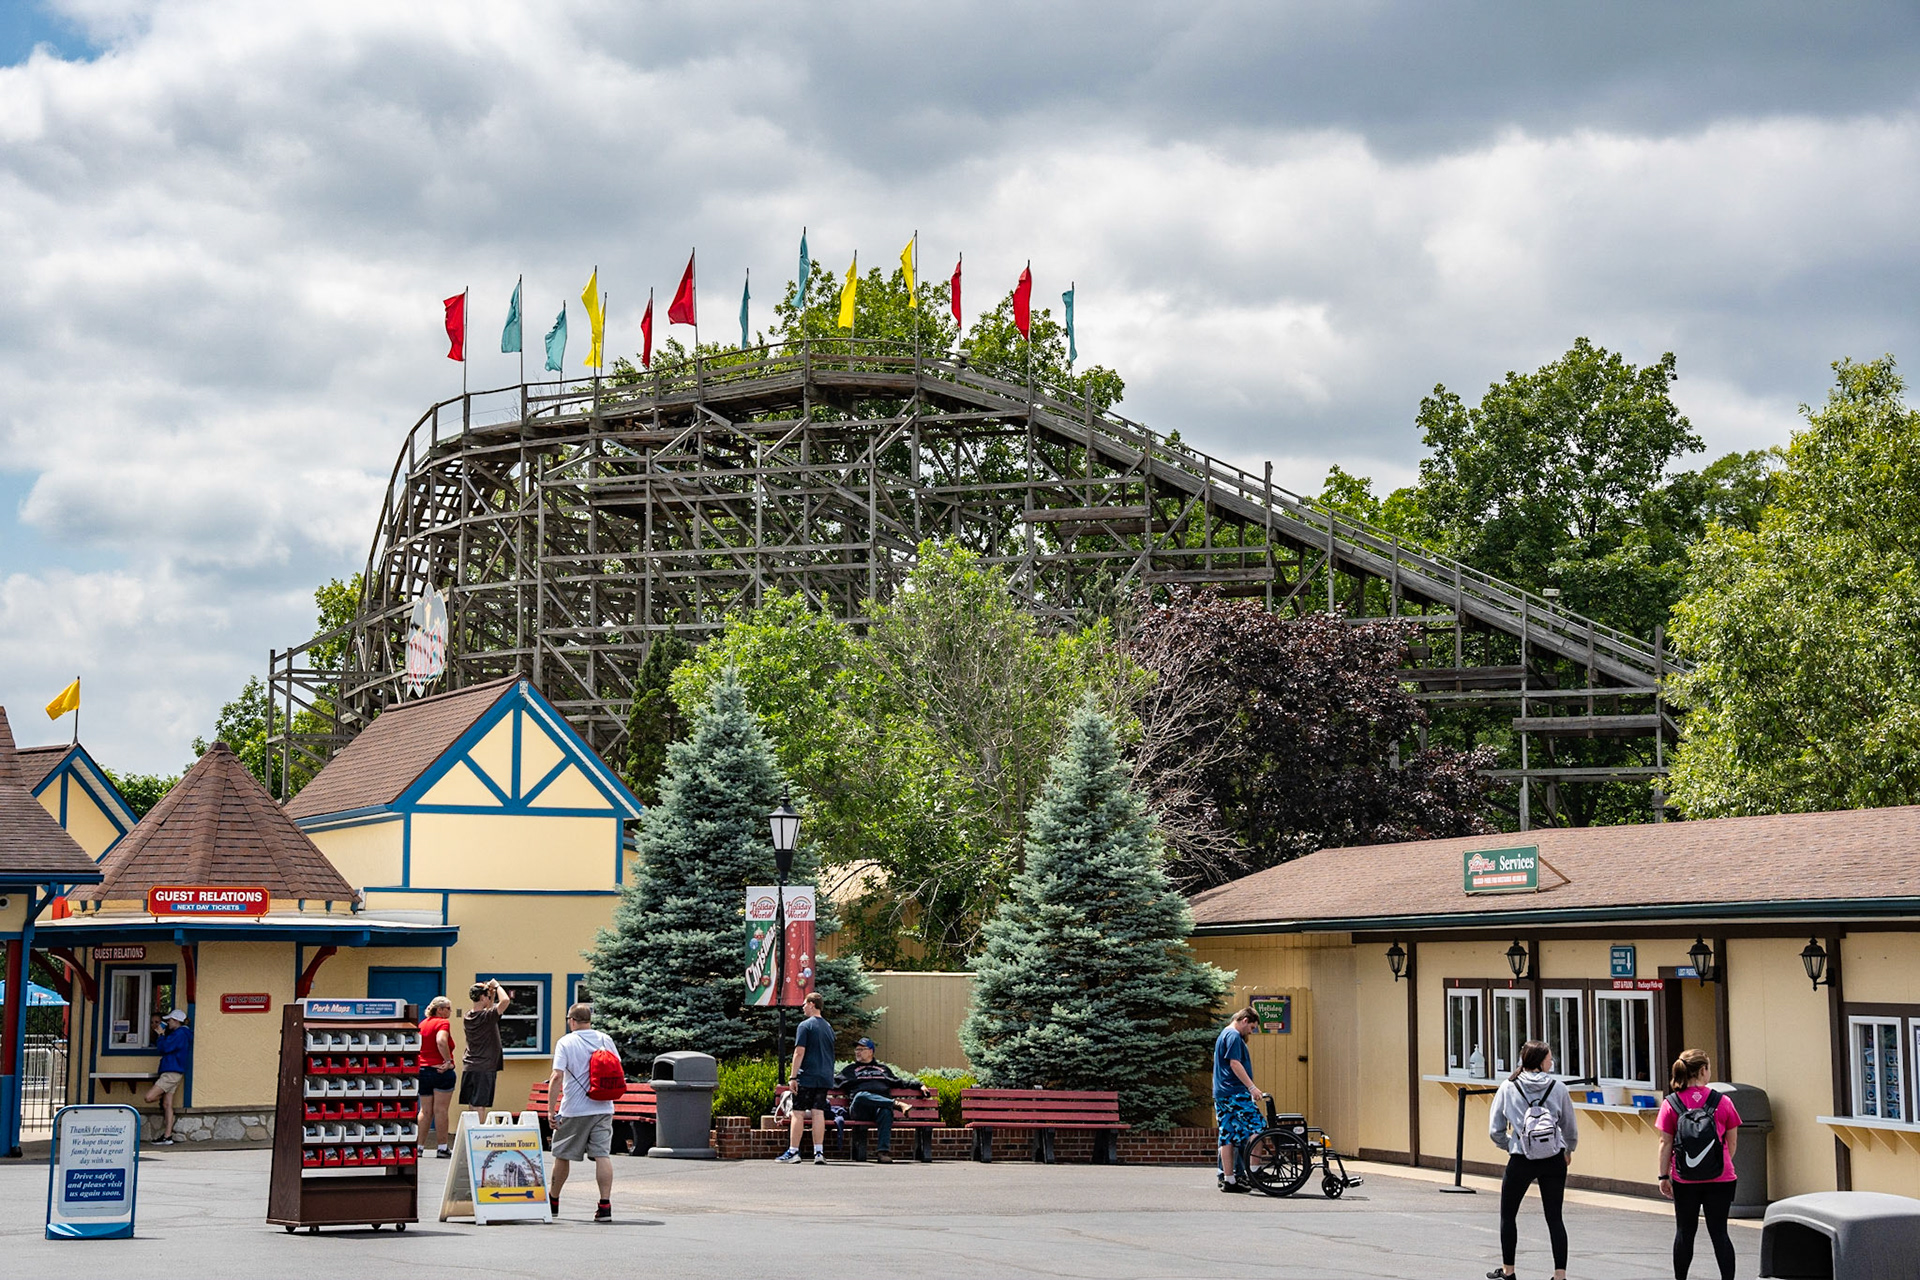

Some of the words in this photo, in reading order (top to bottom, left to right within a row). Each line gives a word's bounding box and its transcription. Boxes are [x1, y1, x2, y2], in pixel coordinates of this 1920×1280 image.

[1500, 853, 1534, 871] Services
[155, 891, 195, 902] GUEST
[199, 891, 263, 902] RELATIONS
[750, 901, 777, 912] Holiday
[785, 901, 812, 912] Holiday
[750, 909, 772, 919] World
[785, 909, 808, 919] World
[94, 948, 112, 959] GUEST
[113, 947, 144, 959] RELATIONS
[1613, 980, 1621, 989] LOST
[1623, 980, 1634, 989] FOUND
[312, 1003, 330, 1012] Park
[331, 1003, 351, 1013] Maps
[1258, 1003, 1283, 1013] Holiday
[70, 1126, 91, 1134] Thanks
[92, 1126, 101, 1134] for
[102, 1126, 126, 1134] visiting!
[82, 1139, 96, 1147] hope
[485, 1140, 517, 1148] Premium
[518, 1139, 536, 1148] Tours
[71, 1148, 90, 1156] family
[73, 1172, 93, 1180] Drive
[94, 1172, 116, 1180] safely
[82, 1181, 106, 1189] please
[79, 1190, 100, 1198] again
